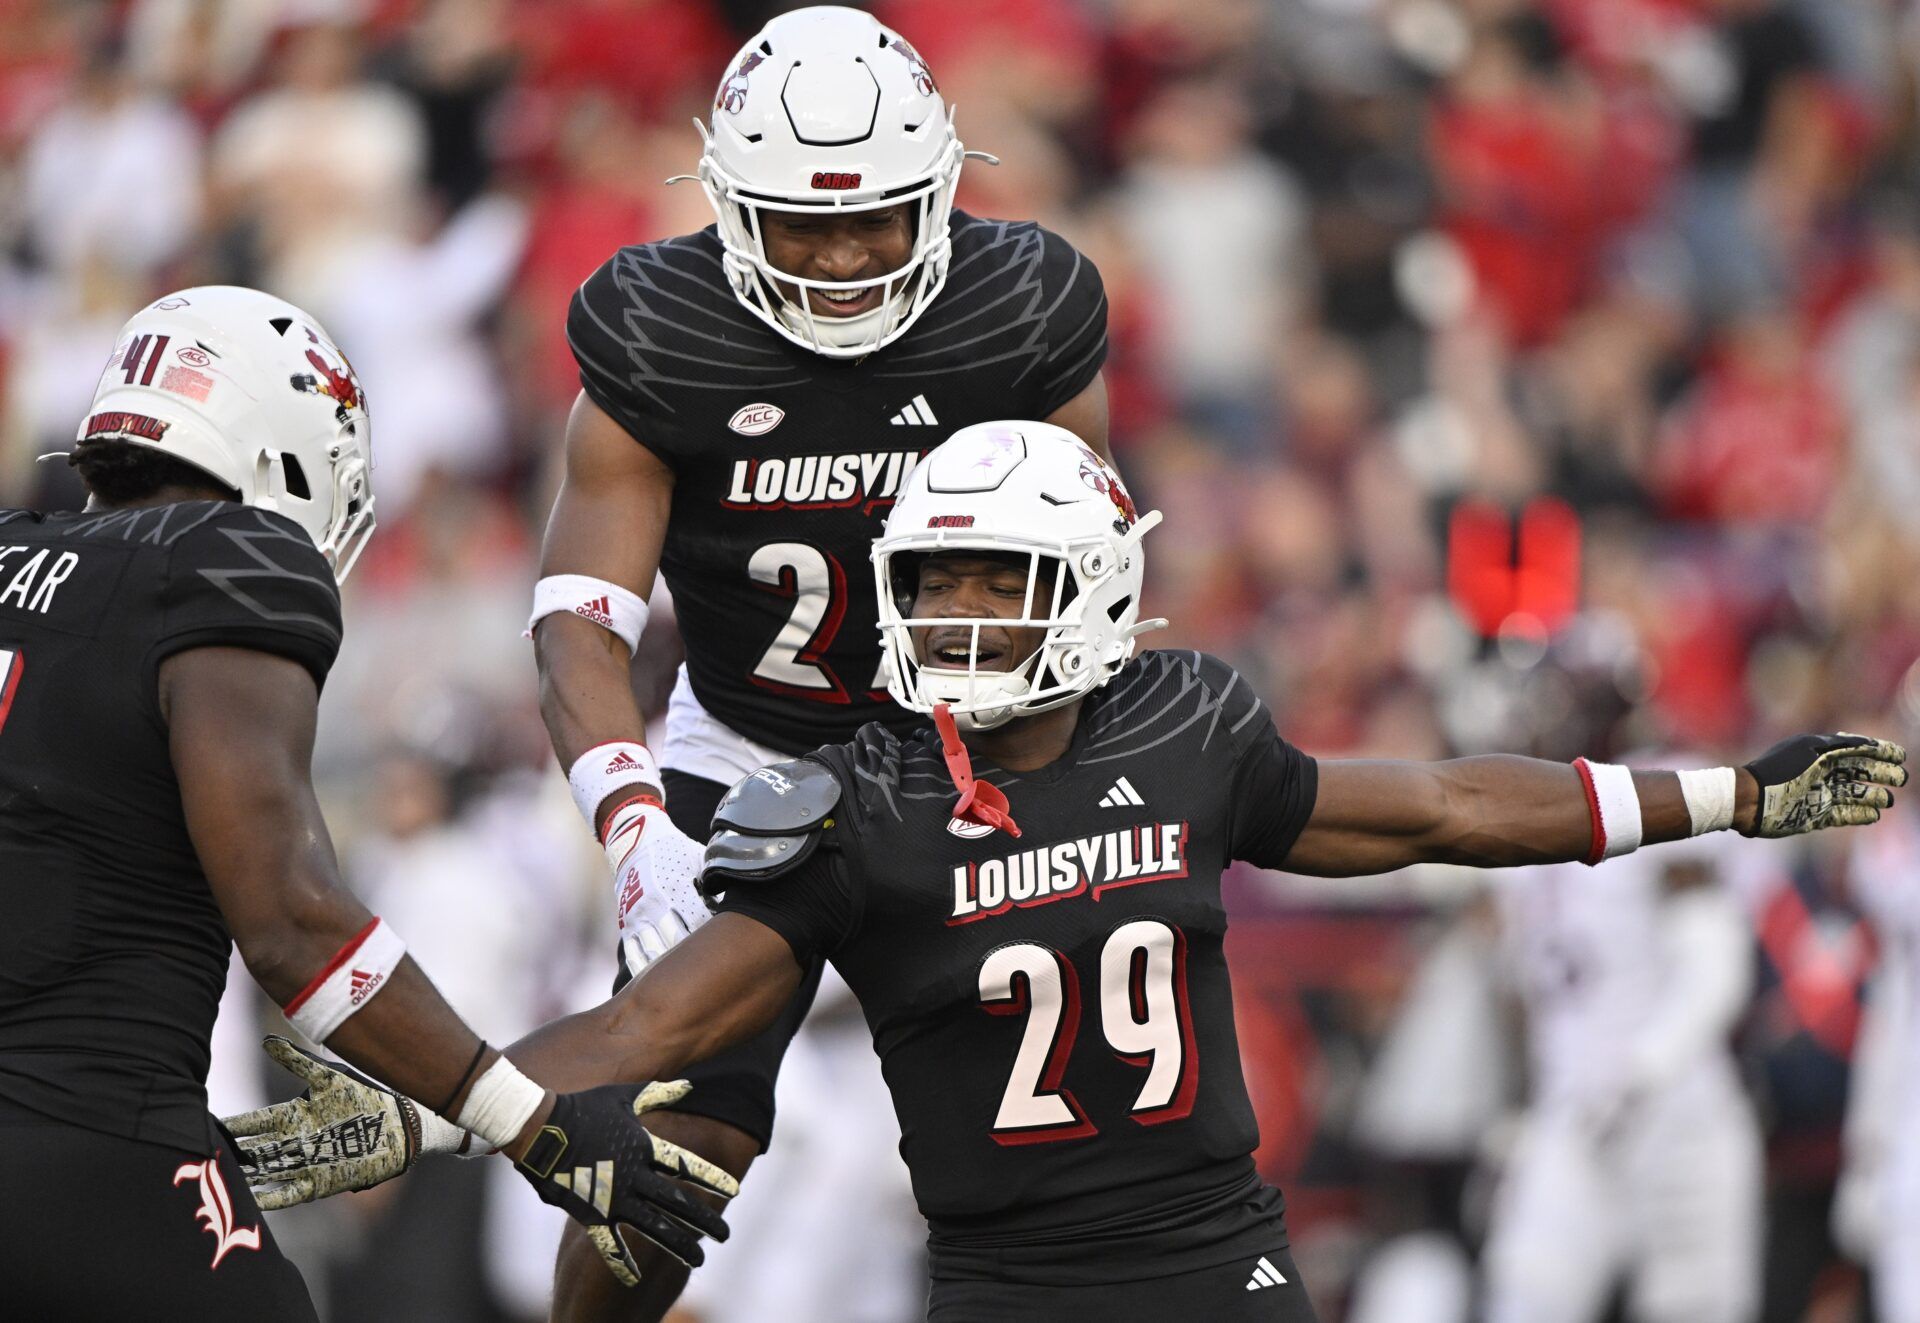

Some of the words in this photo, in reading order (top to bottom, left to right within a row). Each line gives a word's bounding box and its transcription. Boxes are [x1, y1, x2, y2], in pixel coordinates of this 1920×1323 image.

[811, 172, 862, 190] CARDS
[120, 334, 171, 386] 41
[181, 350, 205, 363] ACC
[85, 411, 172, 442] LOUISVILLE
[739, 410, 774, 424] ACC
[927, 515, 974, 528] CARDS
[575, 604, 614, 627] adidas
[605, 760, 644, 775] adidas
[952, 822, 1188, 922] LOUISVILLE
[351, 972, 384, 1006] adidas
[977, 920, 1197, 1145] 29
